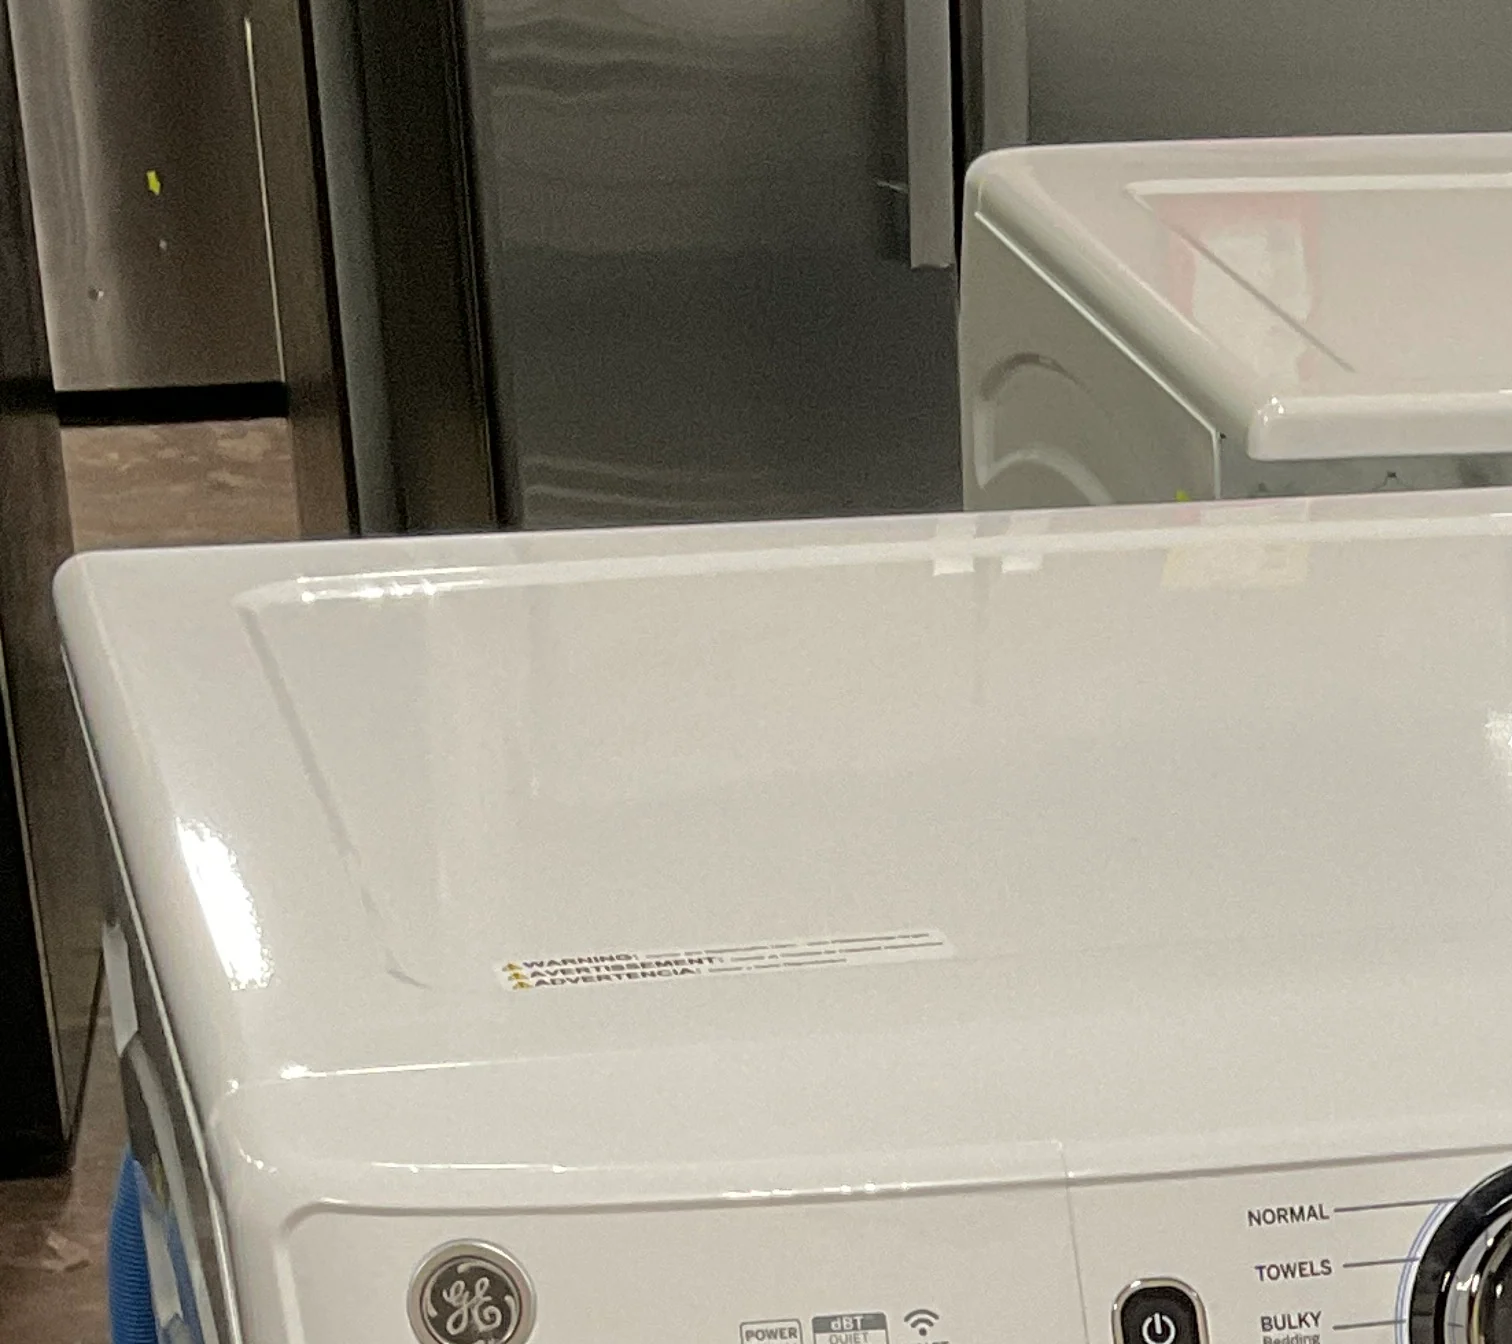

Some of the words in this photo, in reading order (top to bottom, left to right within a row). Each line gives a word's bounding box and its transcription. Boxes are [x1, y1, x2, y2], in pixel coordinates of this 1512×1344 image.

[1247, 1203, 1330, 1227] NORMAL
[1255, 1259, 1333, 1282] TOWELS
[830, 1316, 864, 1331] dBT
[1260, 1310, 1322, 1333] BULKY
[744, 1326, 799, 1342] POWER
